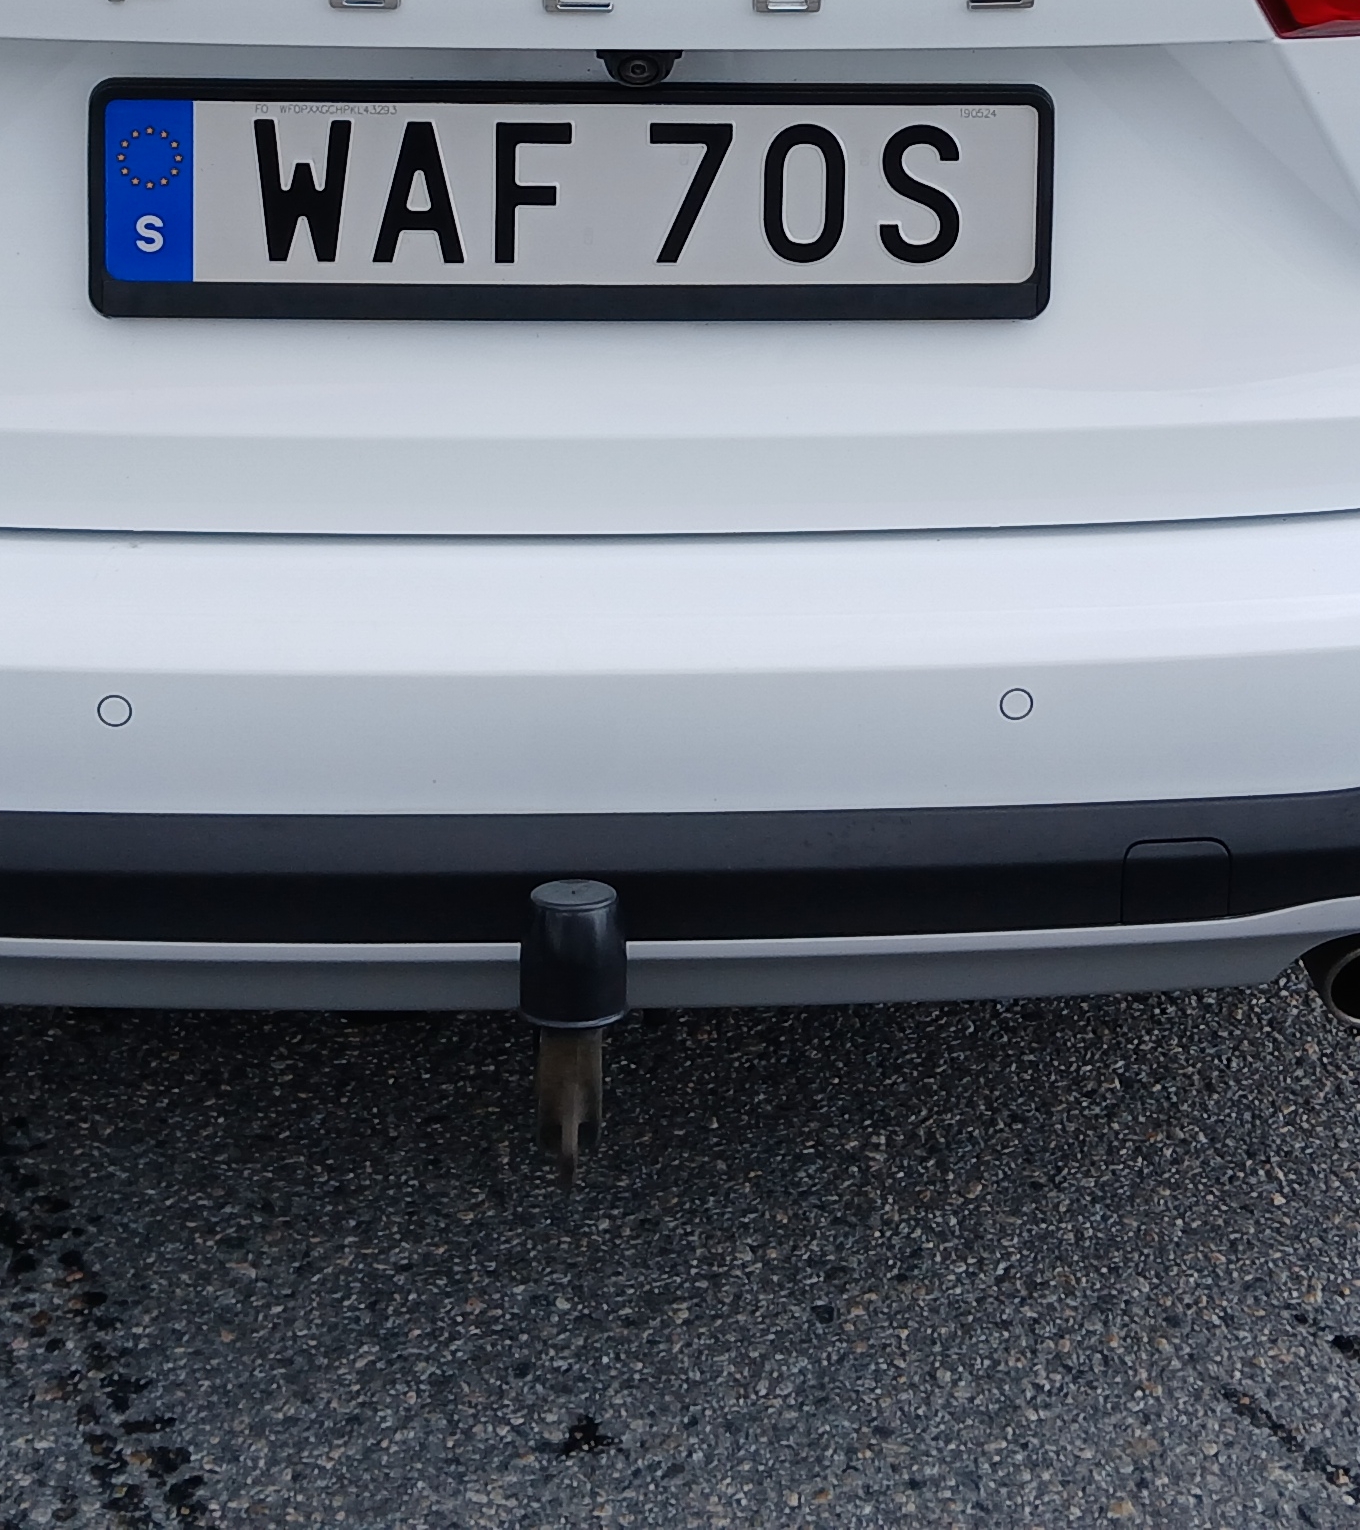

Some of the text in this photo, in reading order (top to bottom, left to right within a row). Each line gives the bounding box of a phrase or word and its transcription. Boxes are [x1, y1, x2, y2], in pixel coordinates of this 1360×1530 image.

[136, 215, 164, 253] S
[253, 118, 960, 264] WAF 70S
